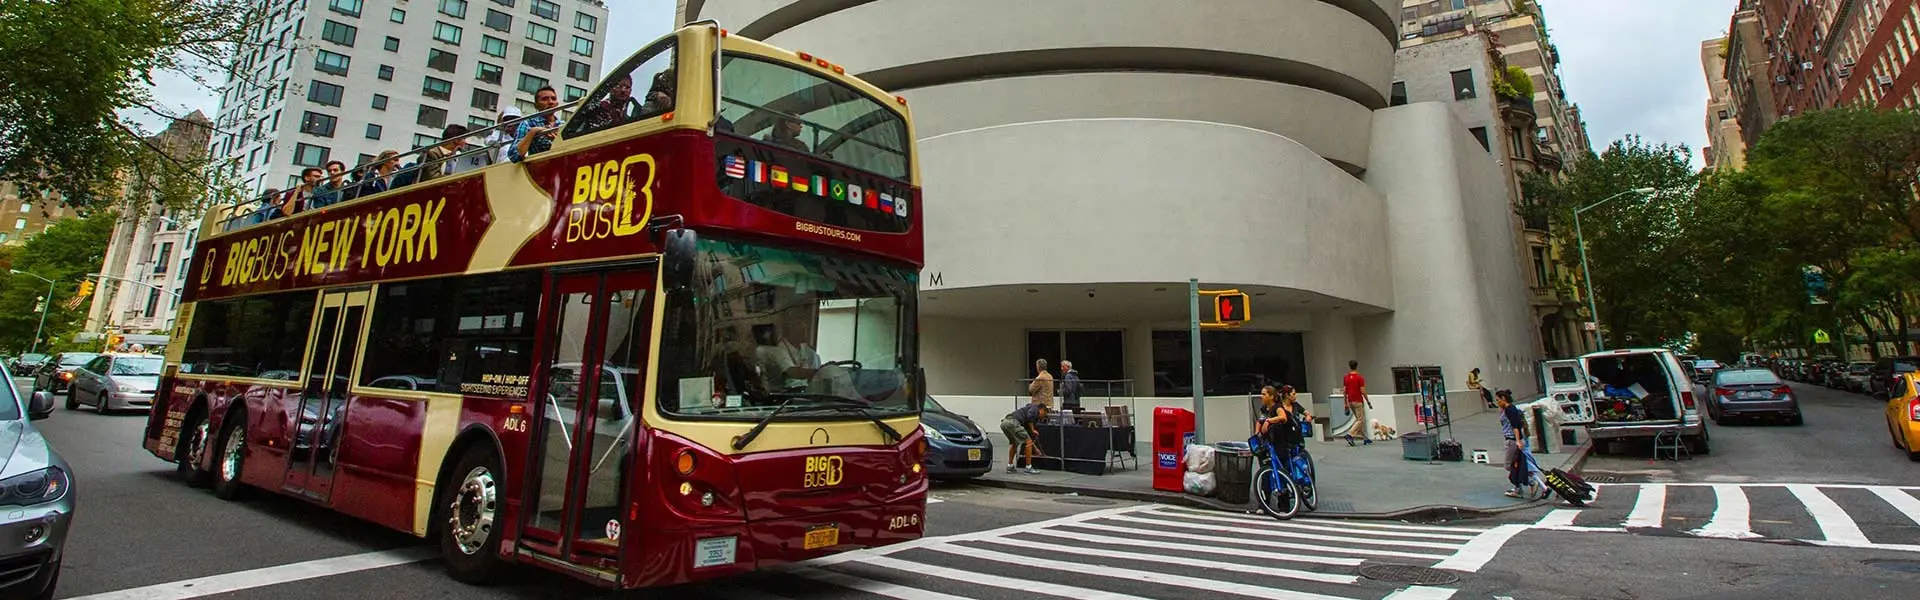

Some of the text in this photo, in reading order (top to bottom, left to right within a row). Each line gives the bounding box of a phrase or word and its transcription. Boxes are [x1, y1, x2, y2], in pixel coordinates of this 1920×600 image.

[572, 159, 618, 204] BIG
[566, 202, 612, 243] BUS
[294, 215, 361, 277] NEW
[360, 196, 447, 269] YORK
[795, 221, 862, 242] BIGBUSTOURS.COM
[929, 271, 944, 287] M
[482, 374, 501, 384] HOP-ON
[506, 375, 529, 385] HOP-OFF
[461, 383, 528, 397] SIGHTSEEING EXPERIENCES
[503, 417, 527, 433] ADL 6
[805, 456, 828, 473] BIG
[803, 472, 827, 488] BUS
[888, 513, 918, 531] ADL 6
